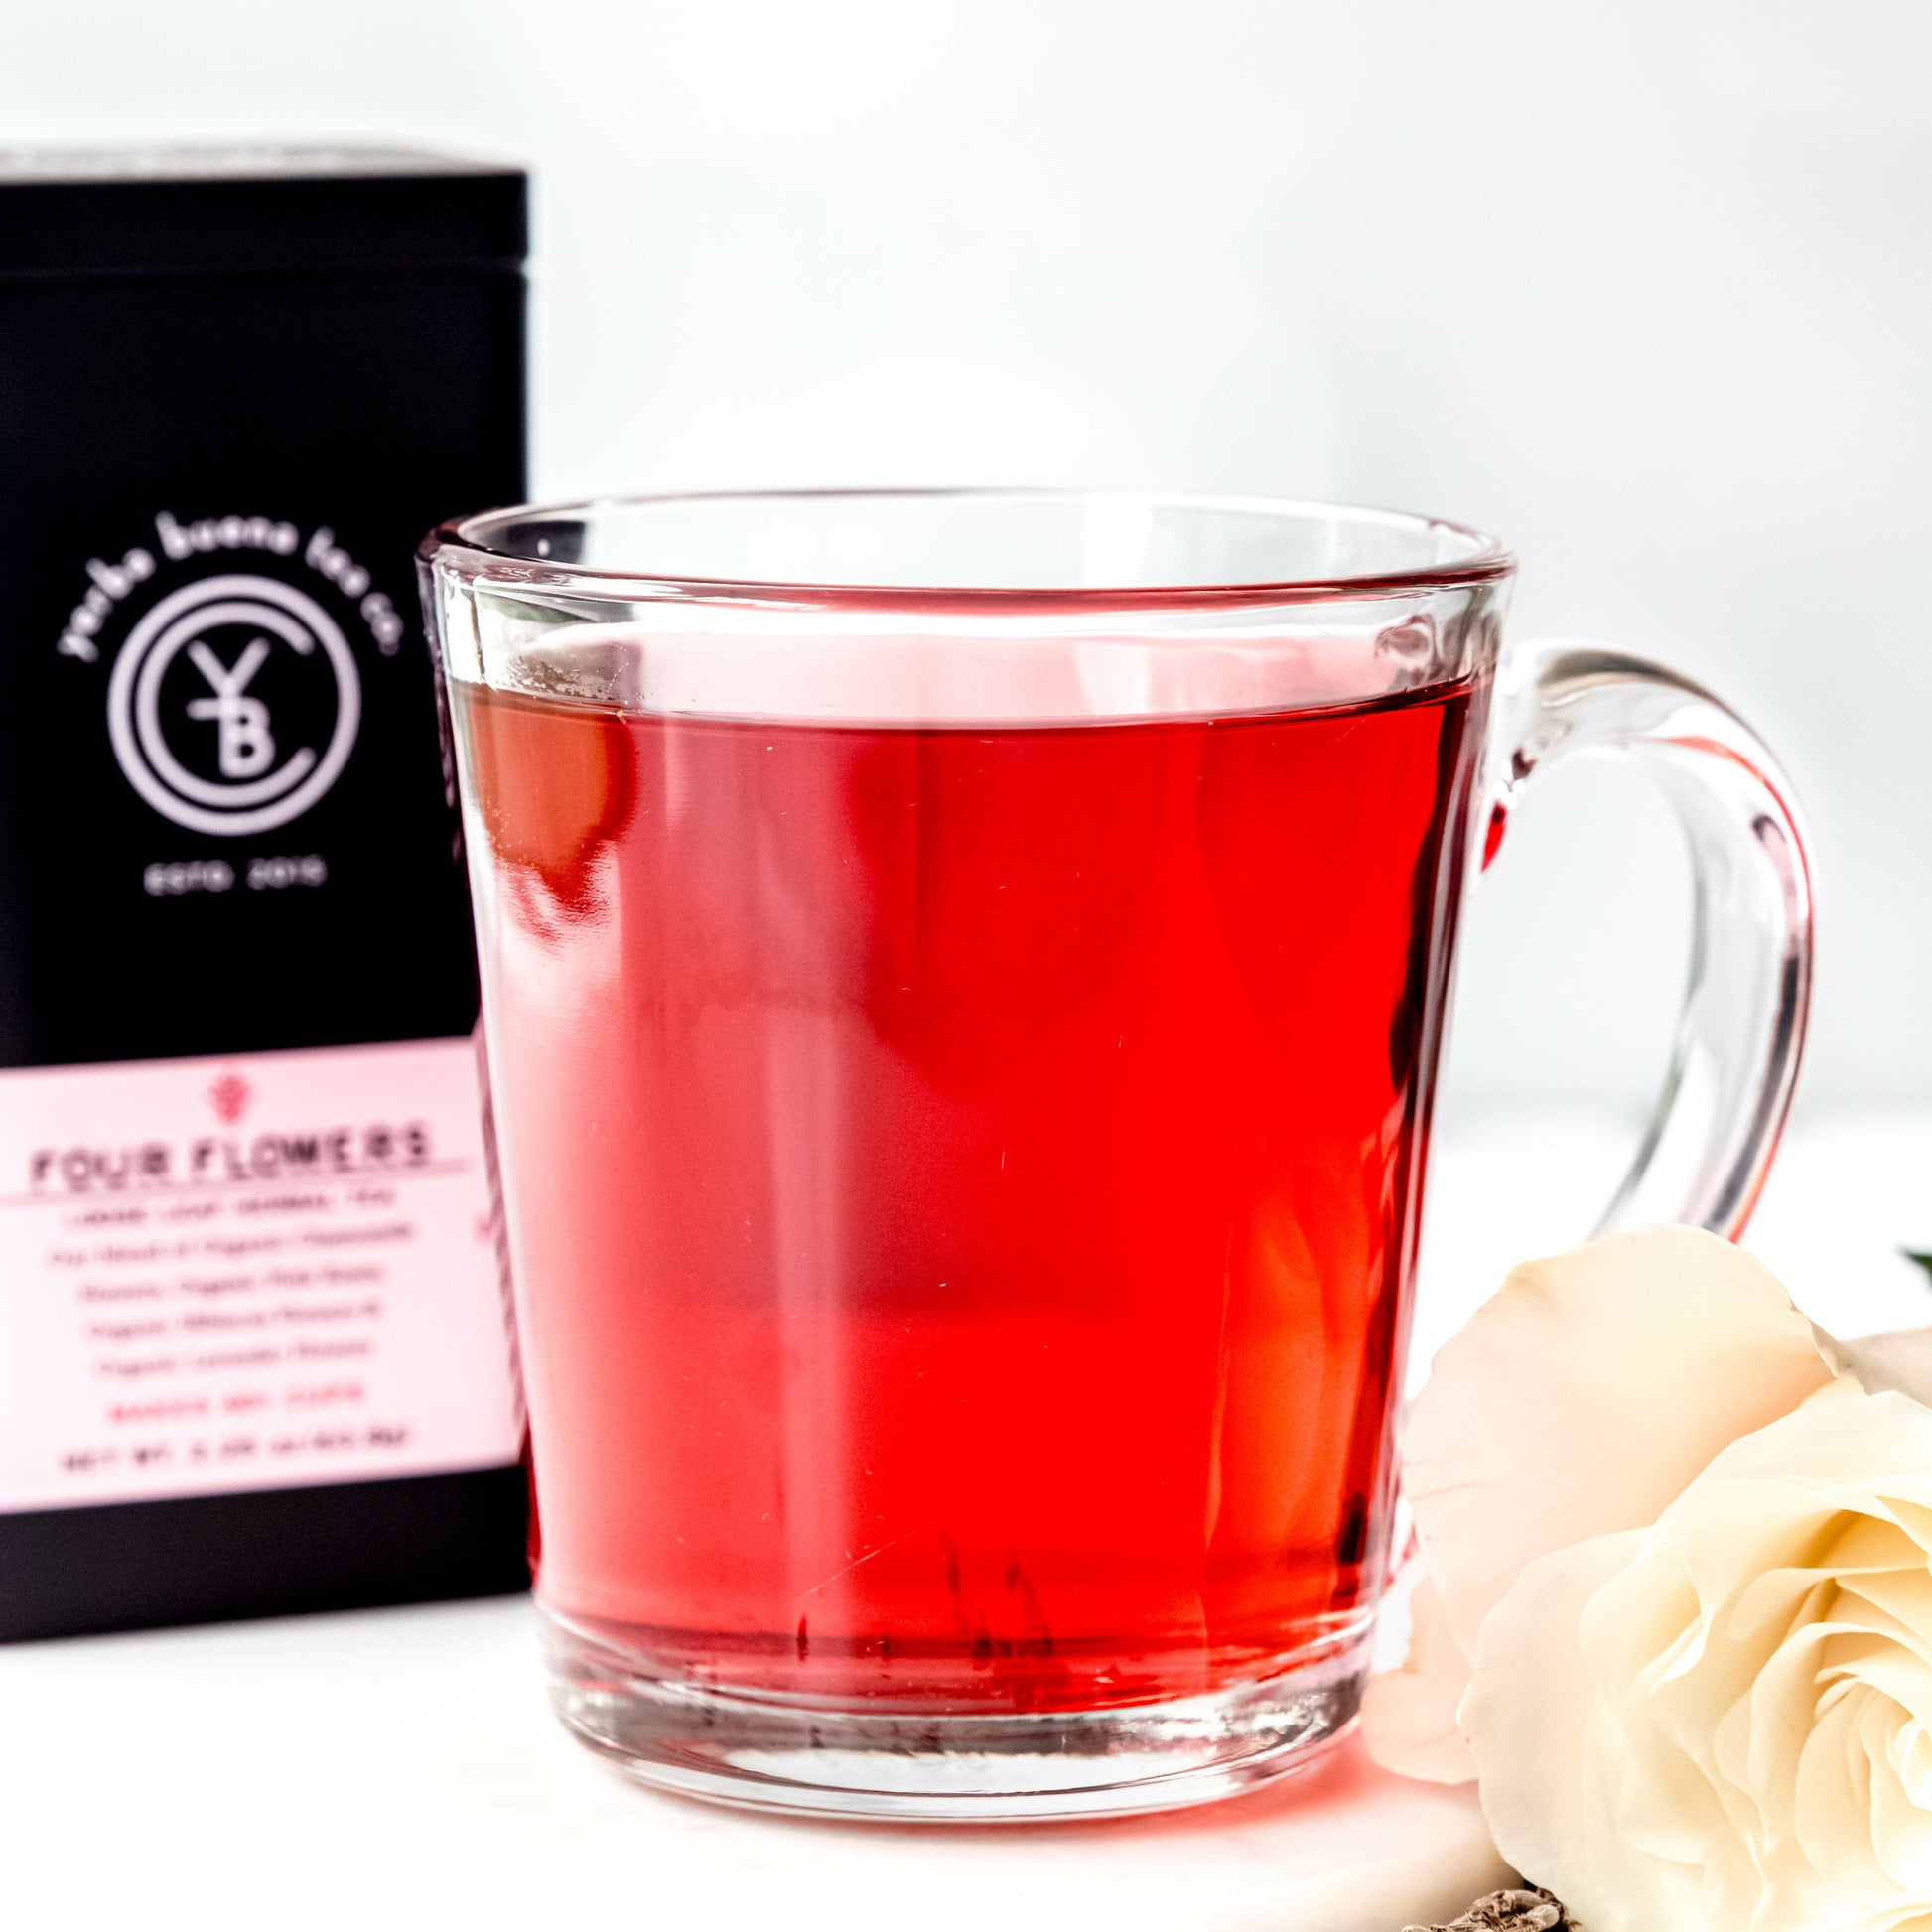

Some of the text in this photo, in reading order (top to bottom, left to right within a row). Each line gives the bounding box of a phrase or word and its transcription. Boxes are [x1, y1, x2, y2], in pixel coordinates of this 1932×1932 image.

[154, 509, 300, 561] buena
[304, 525, 372, 599] tea
[31, 1120, 432, 1191] FOUR FLOWERS
